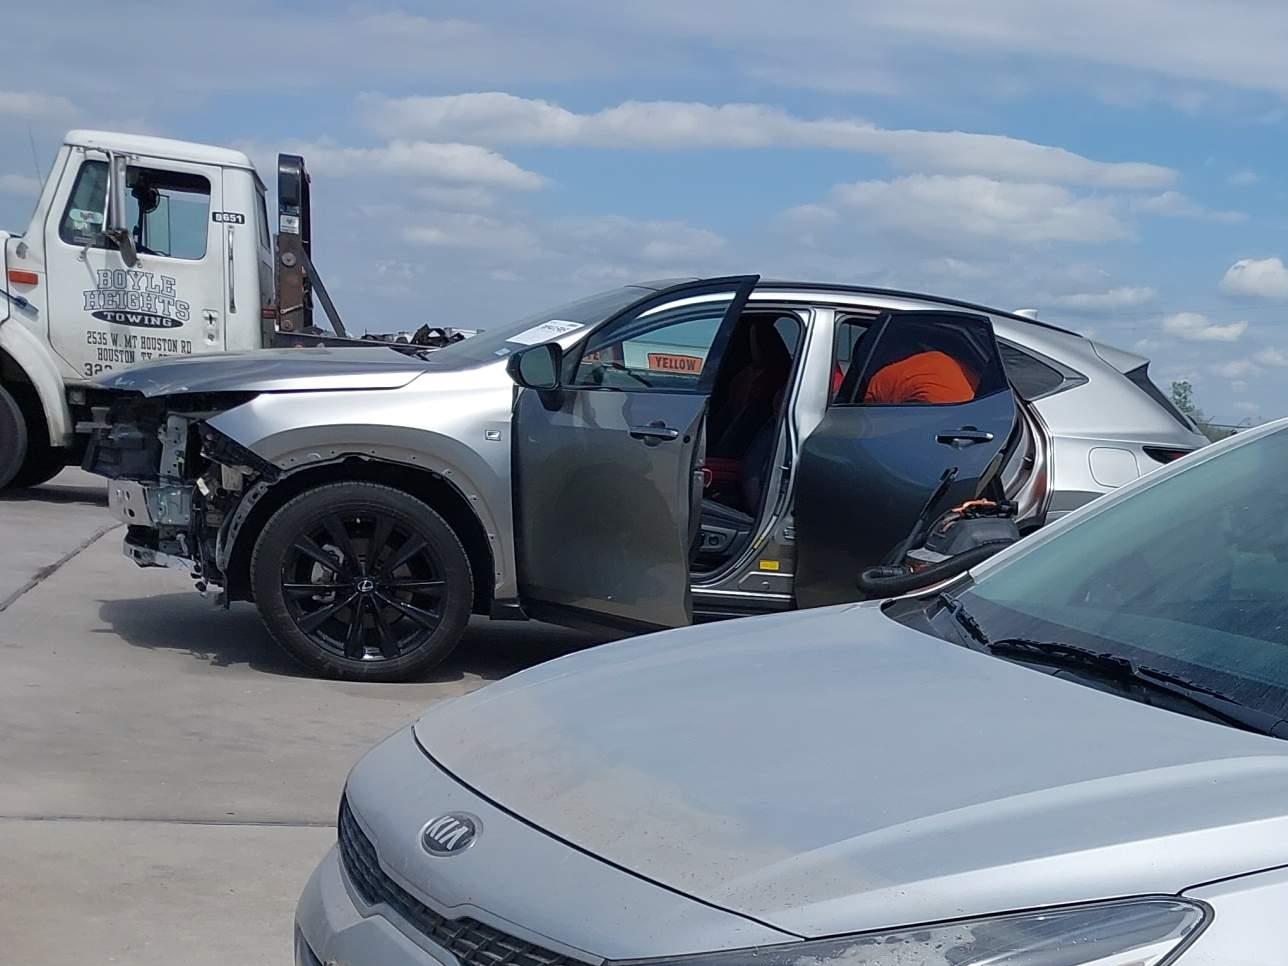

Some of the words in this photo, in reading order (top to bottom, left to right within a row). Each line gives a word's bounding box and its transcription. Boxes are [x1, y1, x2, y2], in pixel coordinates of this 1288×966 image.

[97, 269, 176, 298] BOYLE
[83, 290, 190, 321] HEIGHTS
[103, 312, 173, 326] TOWING
[86, 331, 108, 345] 2535
[124, 334, 138, 349] MT
[140, 336, 178, 353] HOUSTON
[181, 340, 192, 354] RD
[97, 348, 135, 363] HOUSTON
[655, 357, 697, 371] YELLOW
[425, 815, 469, 850] KIA
